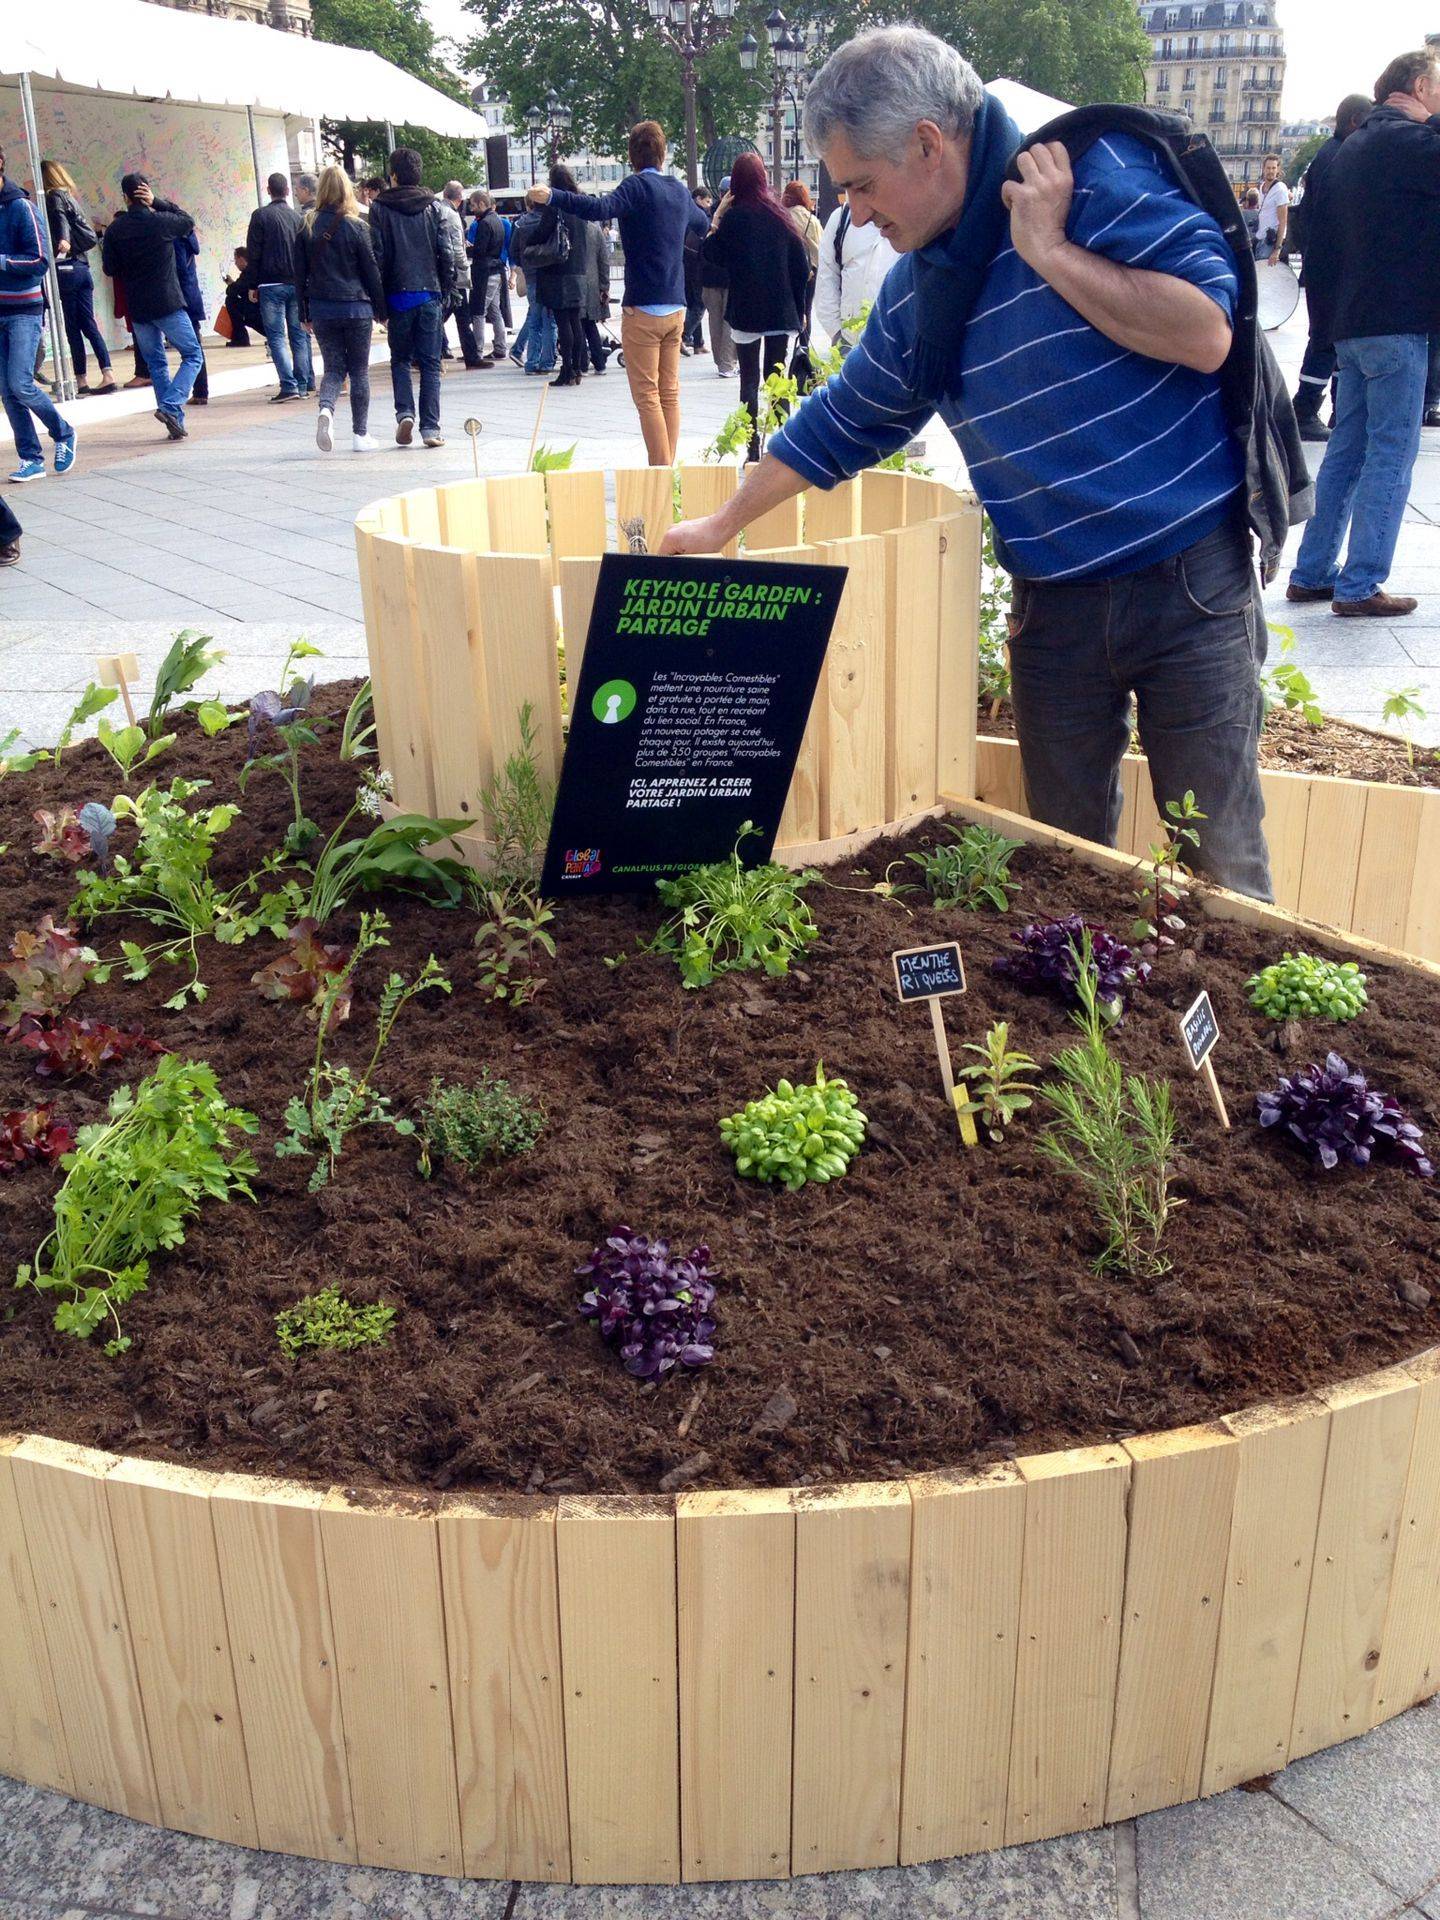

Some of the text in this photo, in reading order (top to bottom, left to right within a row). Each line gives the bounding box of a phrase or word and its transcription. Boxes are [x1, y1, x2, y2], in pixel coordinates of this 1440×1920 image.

[624, 579, 720, 599] KEYHOLE
[724, 583, 811, 604] GARDEN
[619, 598, 788, 621] JARDIN URBAIN
[616, 617, 711, 636] PARTAGE
[653, 671, 781, 684] Les "Incroyables Comestibles"
[650, 683, 683, 693] mettent
[703, 685, 745, 694] nourriture
[747, 685, 770, 694] saine
[648, 694, 771, 706] et gratuite à portée de main,
[646, 705, 766, 716] dans la rue, tout en recréant
[643, 716, 748, 727] du lien social. En France,
[654, 728, 692, 736] nouveau
[693, 728, 728, 738] potager
[742, 727, 762, 736] créé
[639, 737, 672, 748] chaque
[702, 738, 726, 746] existe
[728, 737, 776, 748] aujourd'hui
[636, 748, 655, 758] plus
[656, 748, 669, 757] de
[671, 747, 691, 757] 350
[693, 748, 728, 758] groupes
[692, 759, 703, 767] en
[705, 757, 735, 767] France.
[630, 777, 752, 789] ICI, APPRENEZ A CREER
[629, 788, 752, 798] VOTRE JARDIN URBAIN
[626, 798, 676, 808] PARTAGE
[900, 952, 951, 972] MENTHE
